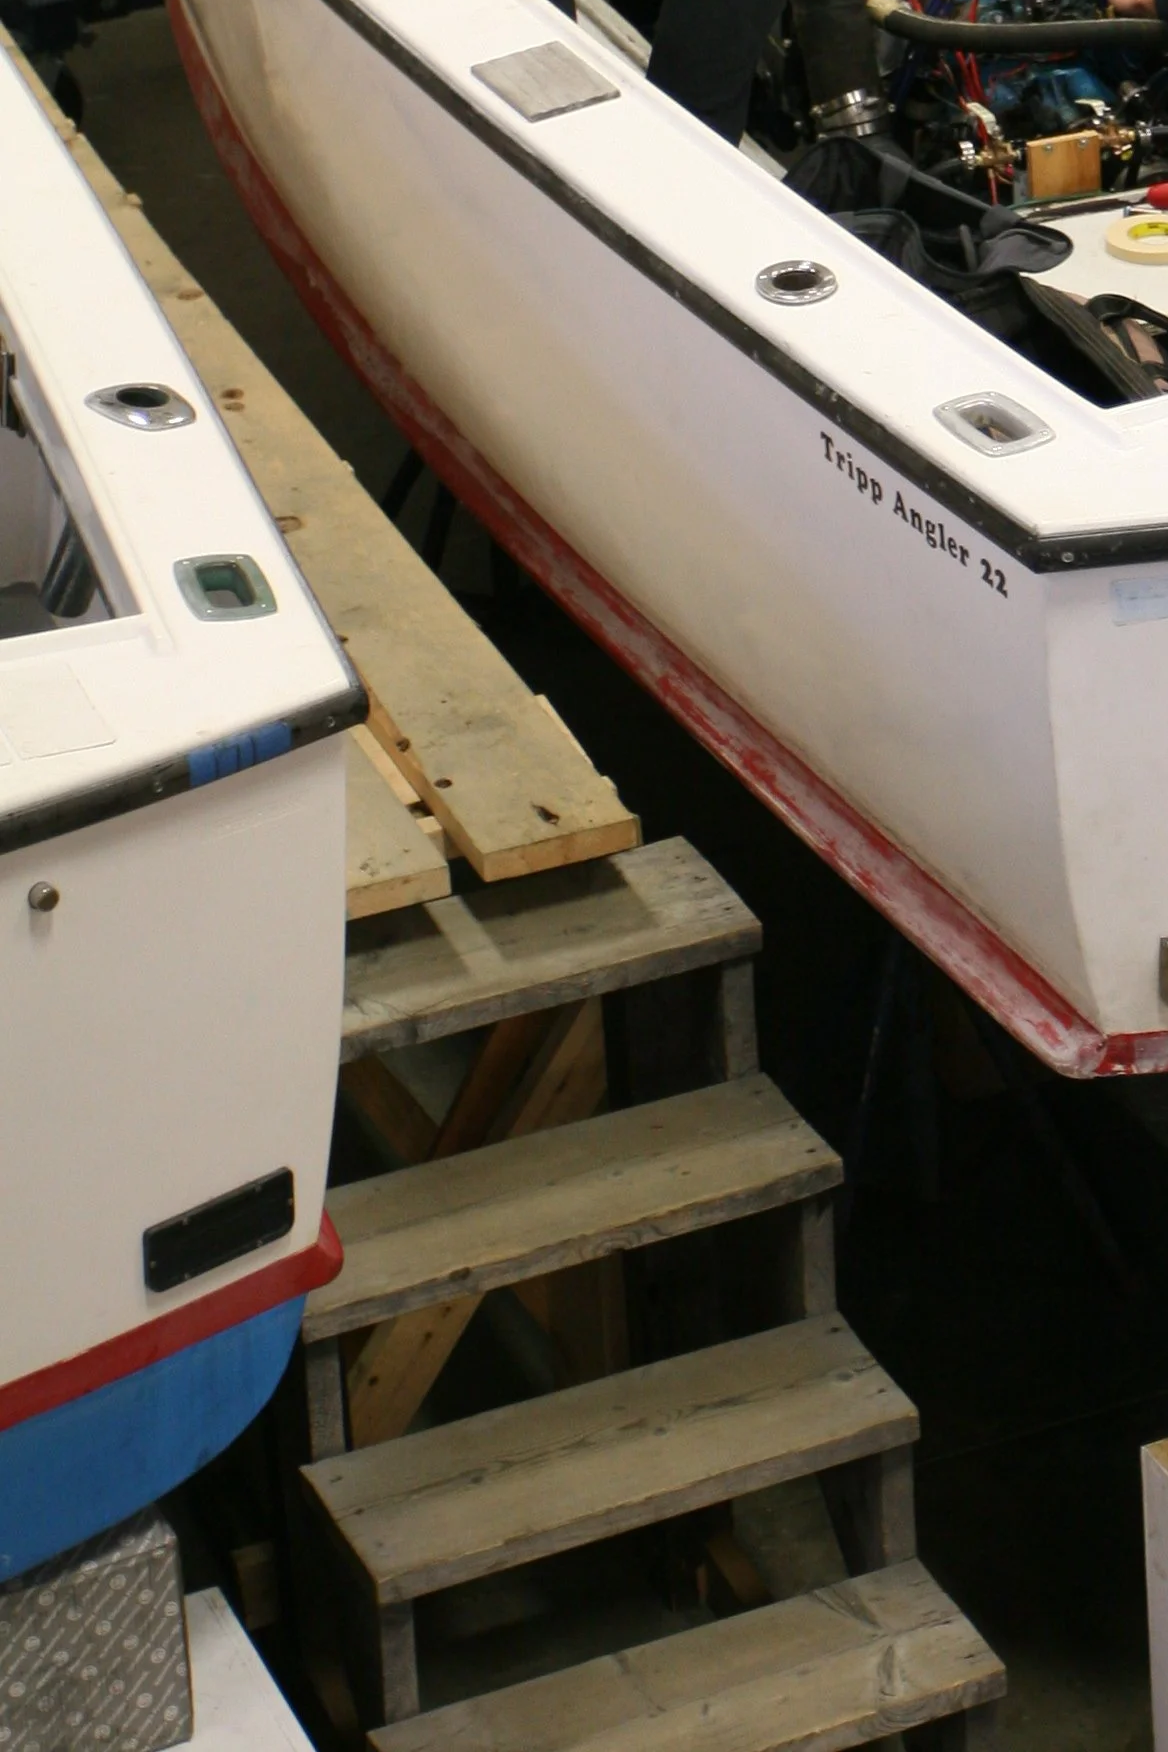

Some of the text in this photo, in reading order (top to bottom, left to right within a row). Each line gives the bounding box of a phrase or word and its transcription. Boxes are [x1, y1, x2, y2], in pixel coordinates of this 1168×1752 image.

[819, 430, 1008, 598] Tripp Angler 22
